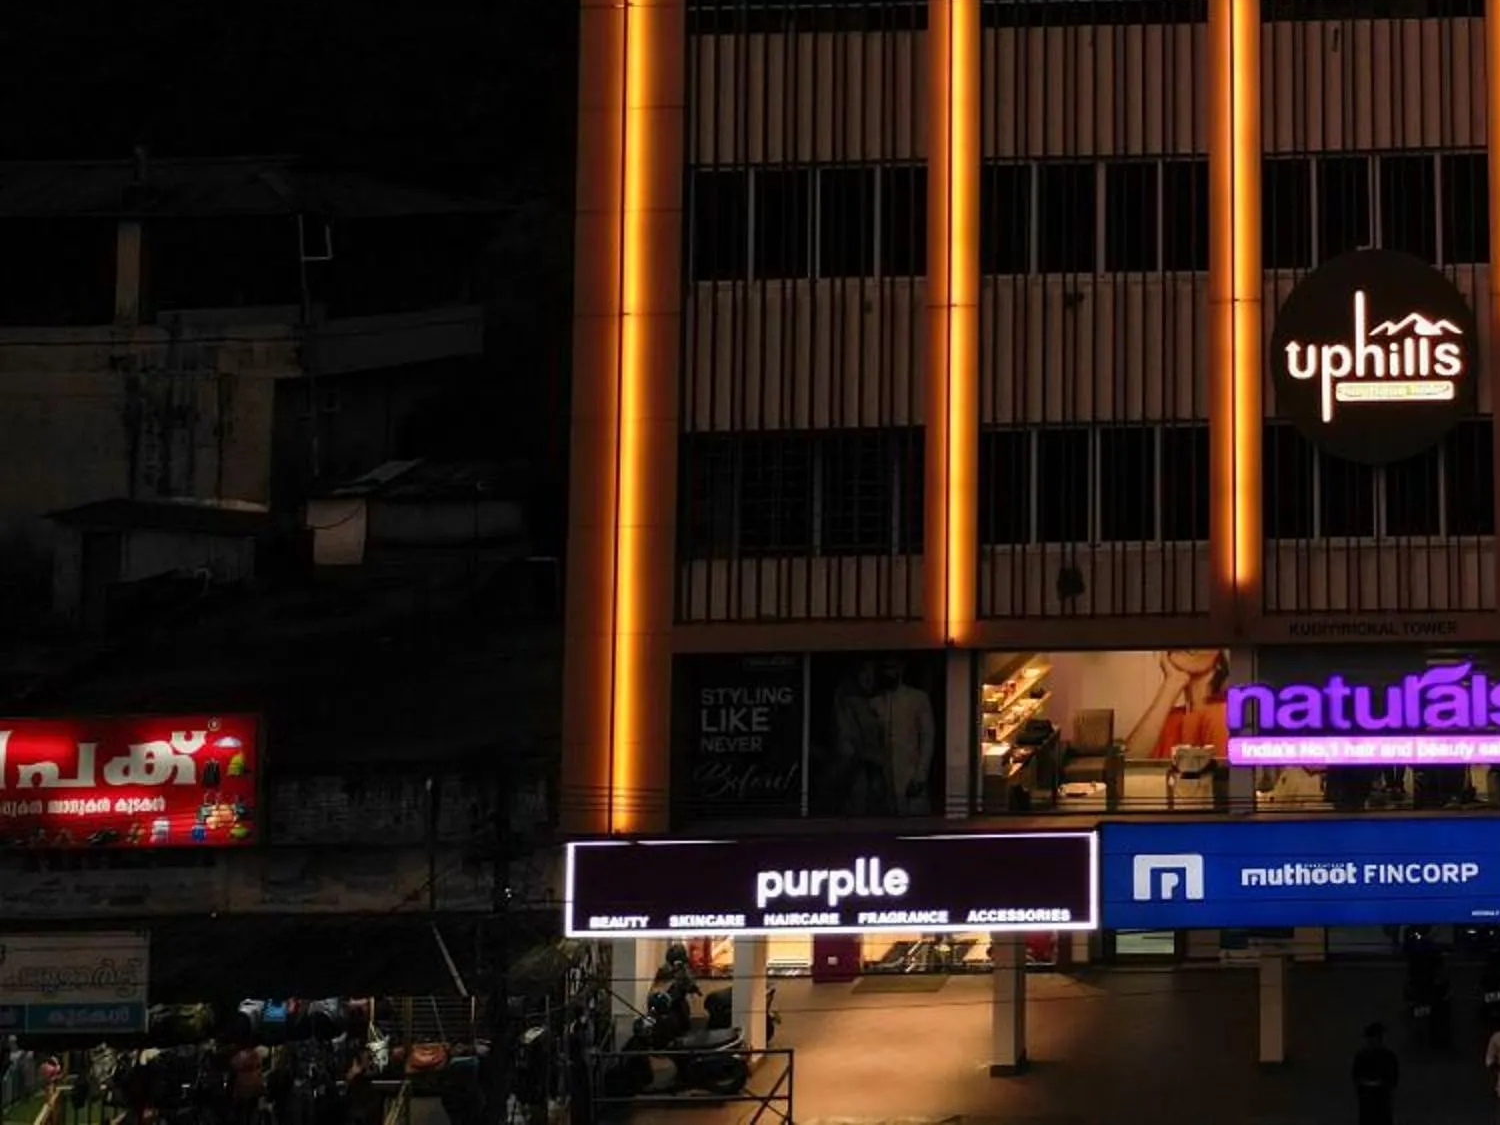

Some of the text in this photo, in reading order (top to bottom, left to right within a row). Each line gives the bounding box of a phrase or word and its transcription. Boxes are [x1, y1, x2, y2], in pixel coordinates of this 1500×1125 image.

[1285, 290, 1463, 423] uphills
[1403, 620, 1457, 635] TOWER
[701, 686, 796, 706] STYLING
[701, 707, 771, 733] LIKE
[701, 735, 763, 754] NEVER
[757, 857, 909, 907] purplle
[1241, 862, 1479, 886] muthoot FINCORP
[590, 908, 1071, 929] BEAUTY SKINCARE HAIRCARE FRAGRANCE ACCESSORIES
